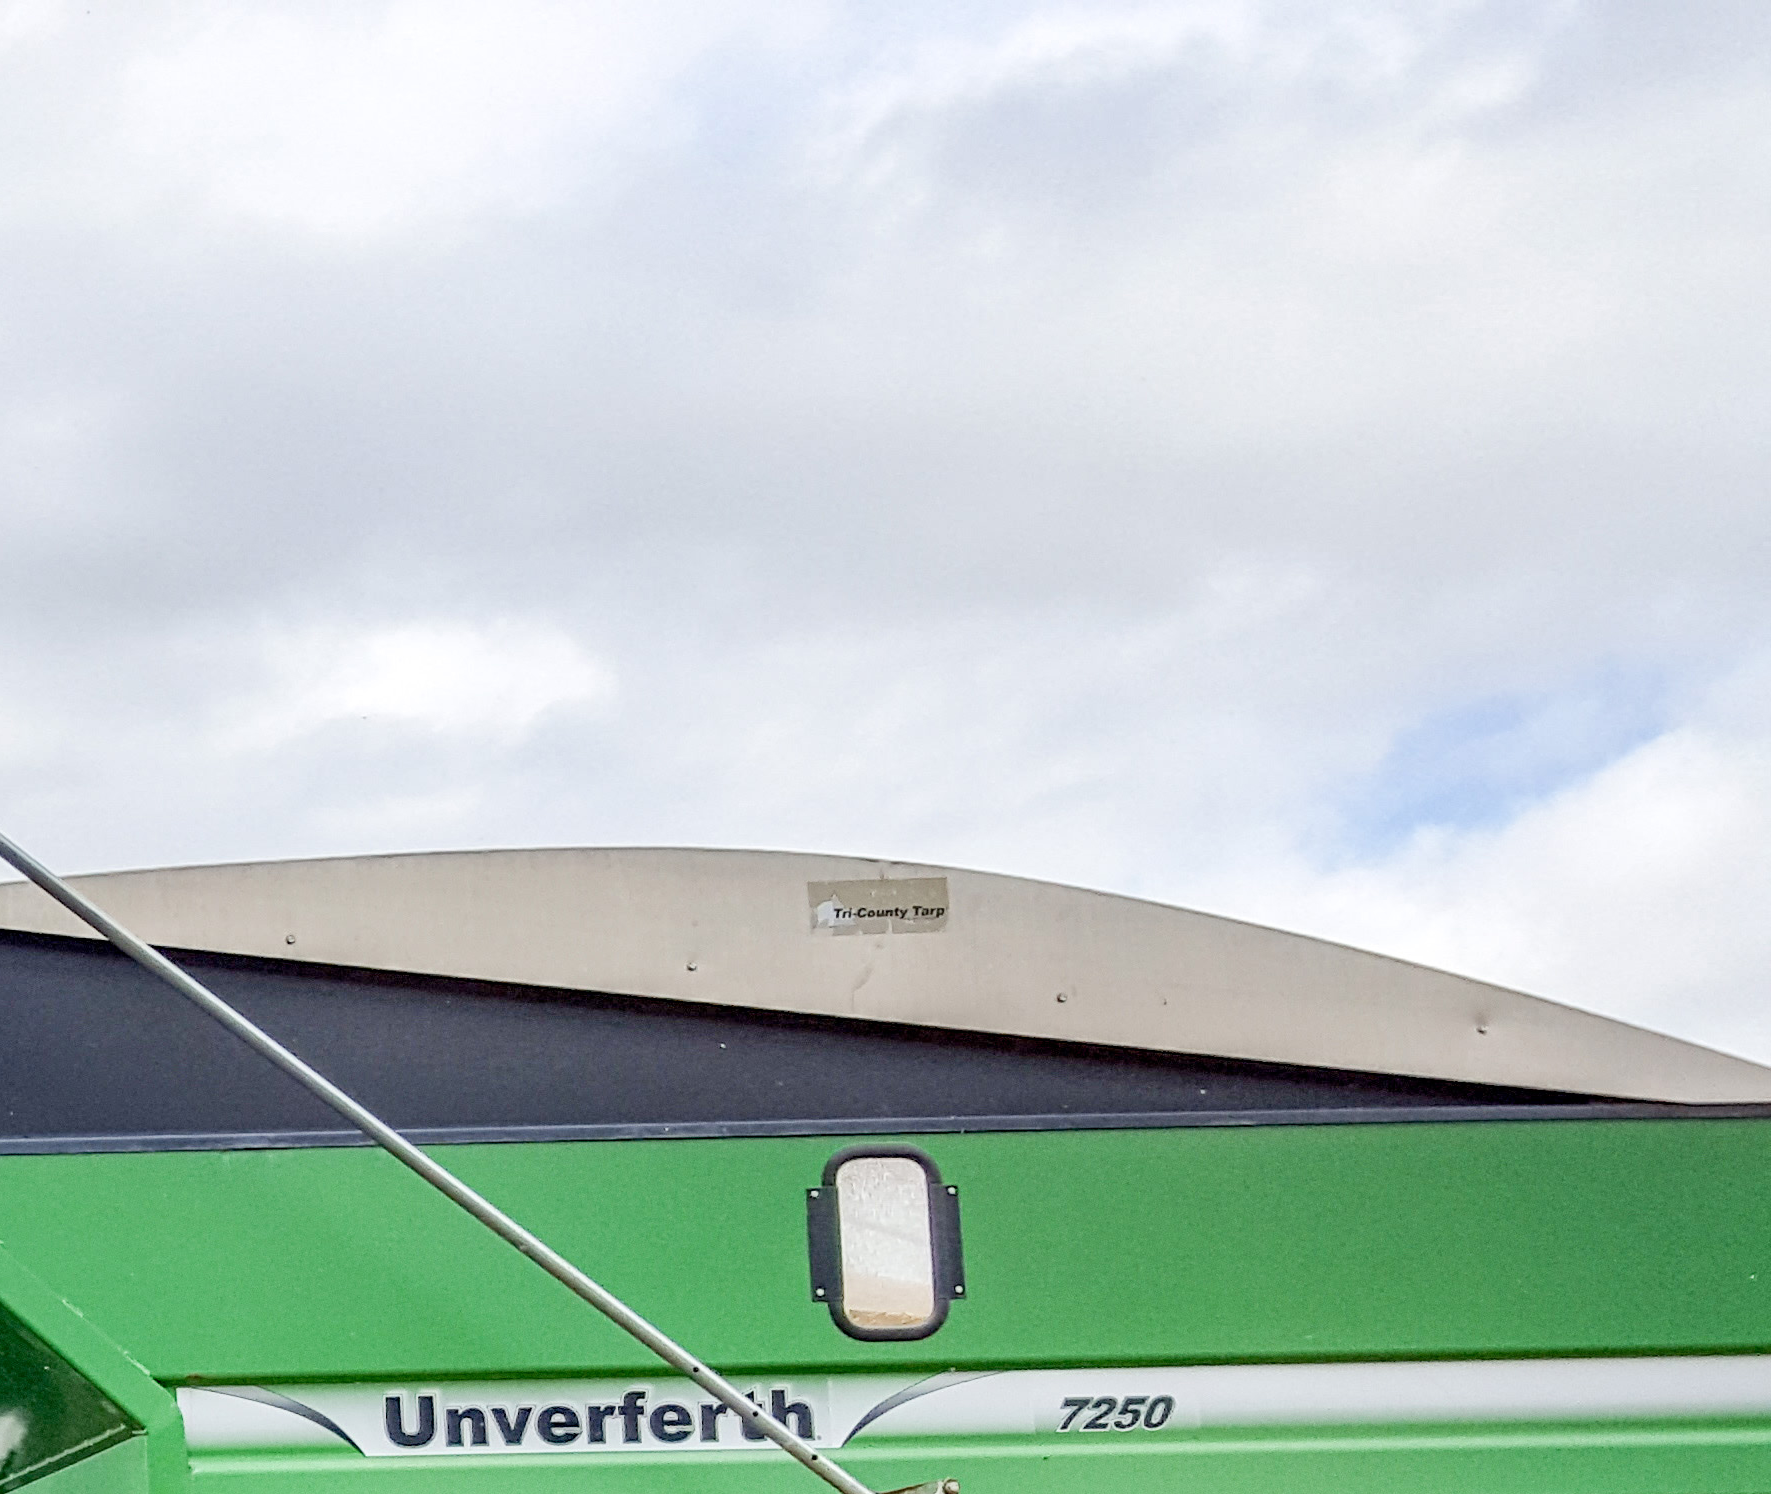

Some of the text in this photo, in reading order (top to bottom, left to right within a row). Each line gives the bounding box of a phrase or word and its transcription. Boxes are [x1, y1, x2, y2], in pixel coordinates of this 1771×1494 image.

[834, 906, 945, 919] Tri-County Tarp
[384, 1388, 1175, 1447] Unverferth 7250
